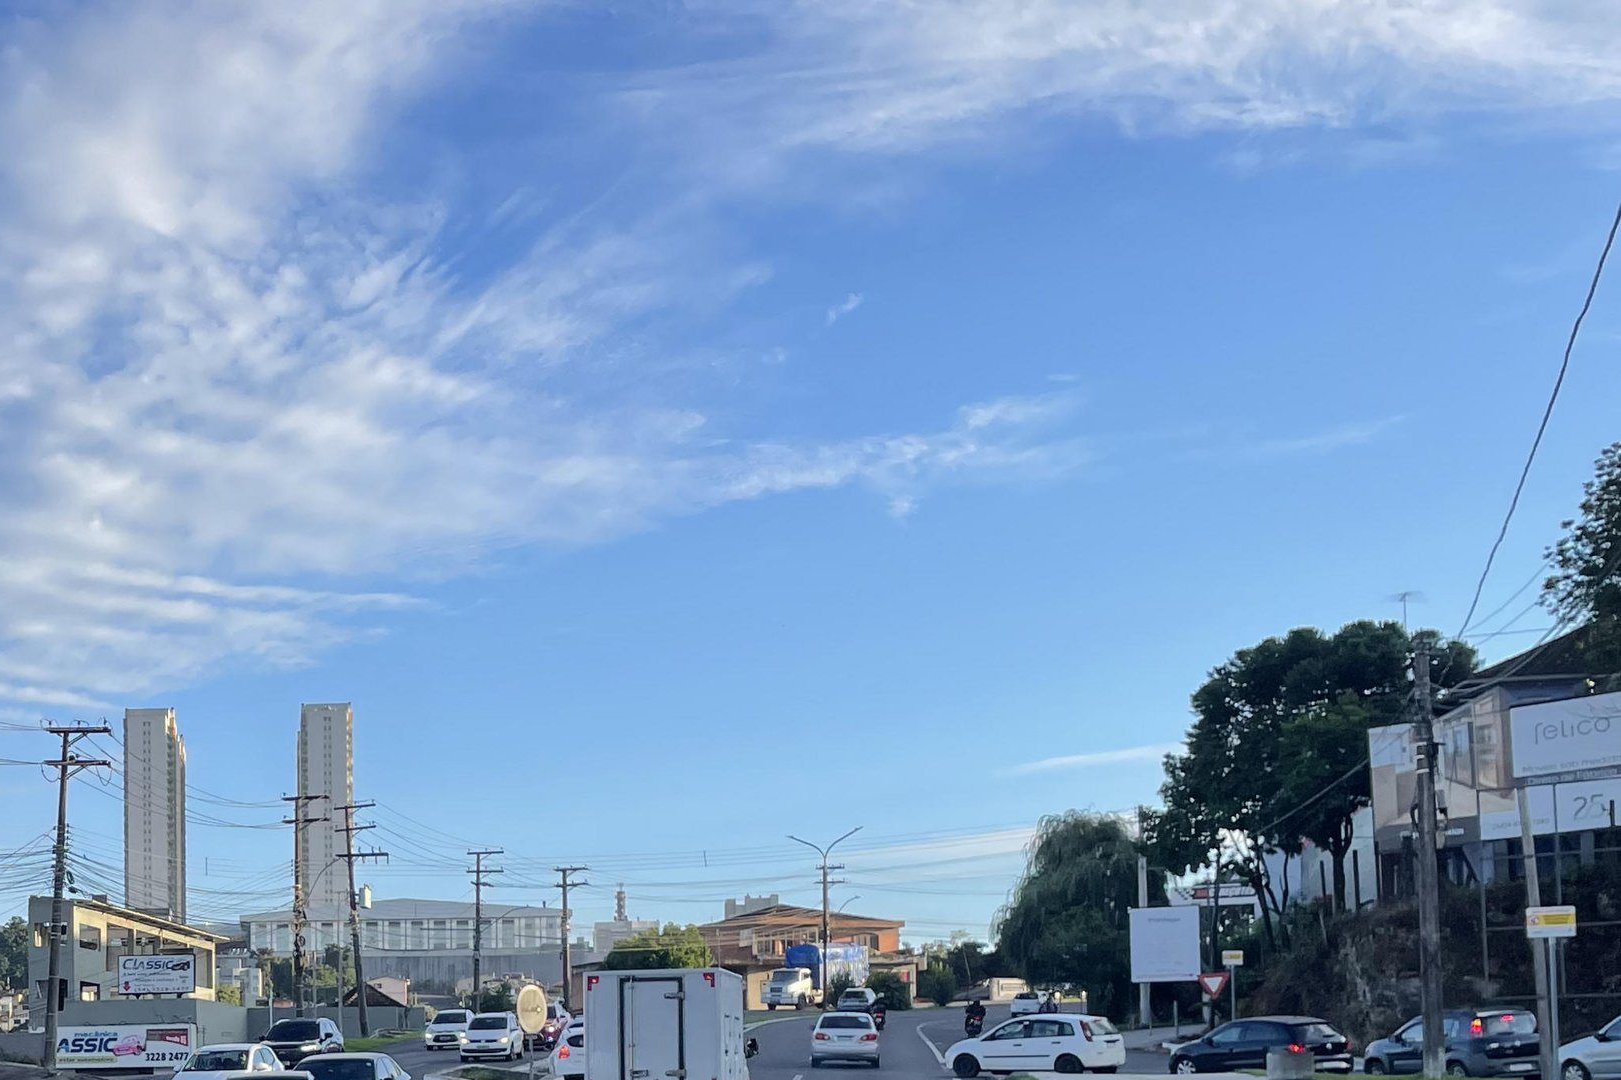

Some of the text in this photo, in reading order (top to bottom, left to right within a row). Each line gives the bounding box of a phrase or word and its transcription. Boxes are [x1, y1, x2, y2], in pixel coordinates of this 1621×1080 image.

[122, 958, 174, 970] CLASSIC
[57, 1037, 118, 1053] ASSIC
[145, 1052, 189, 1061] 3228 2477
